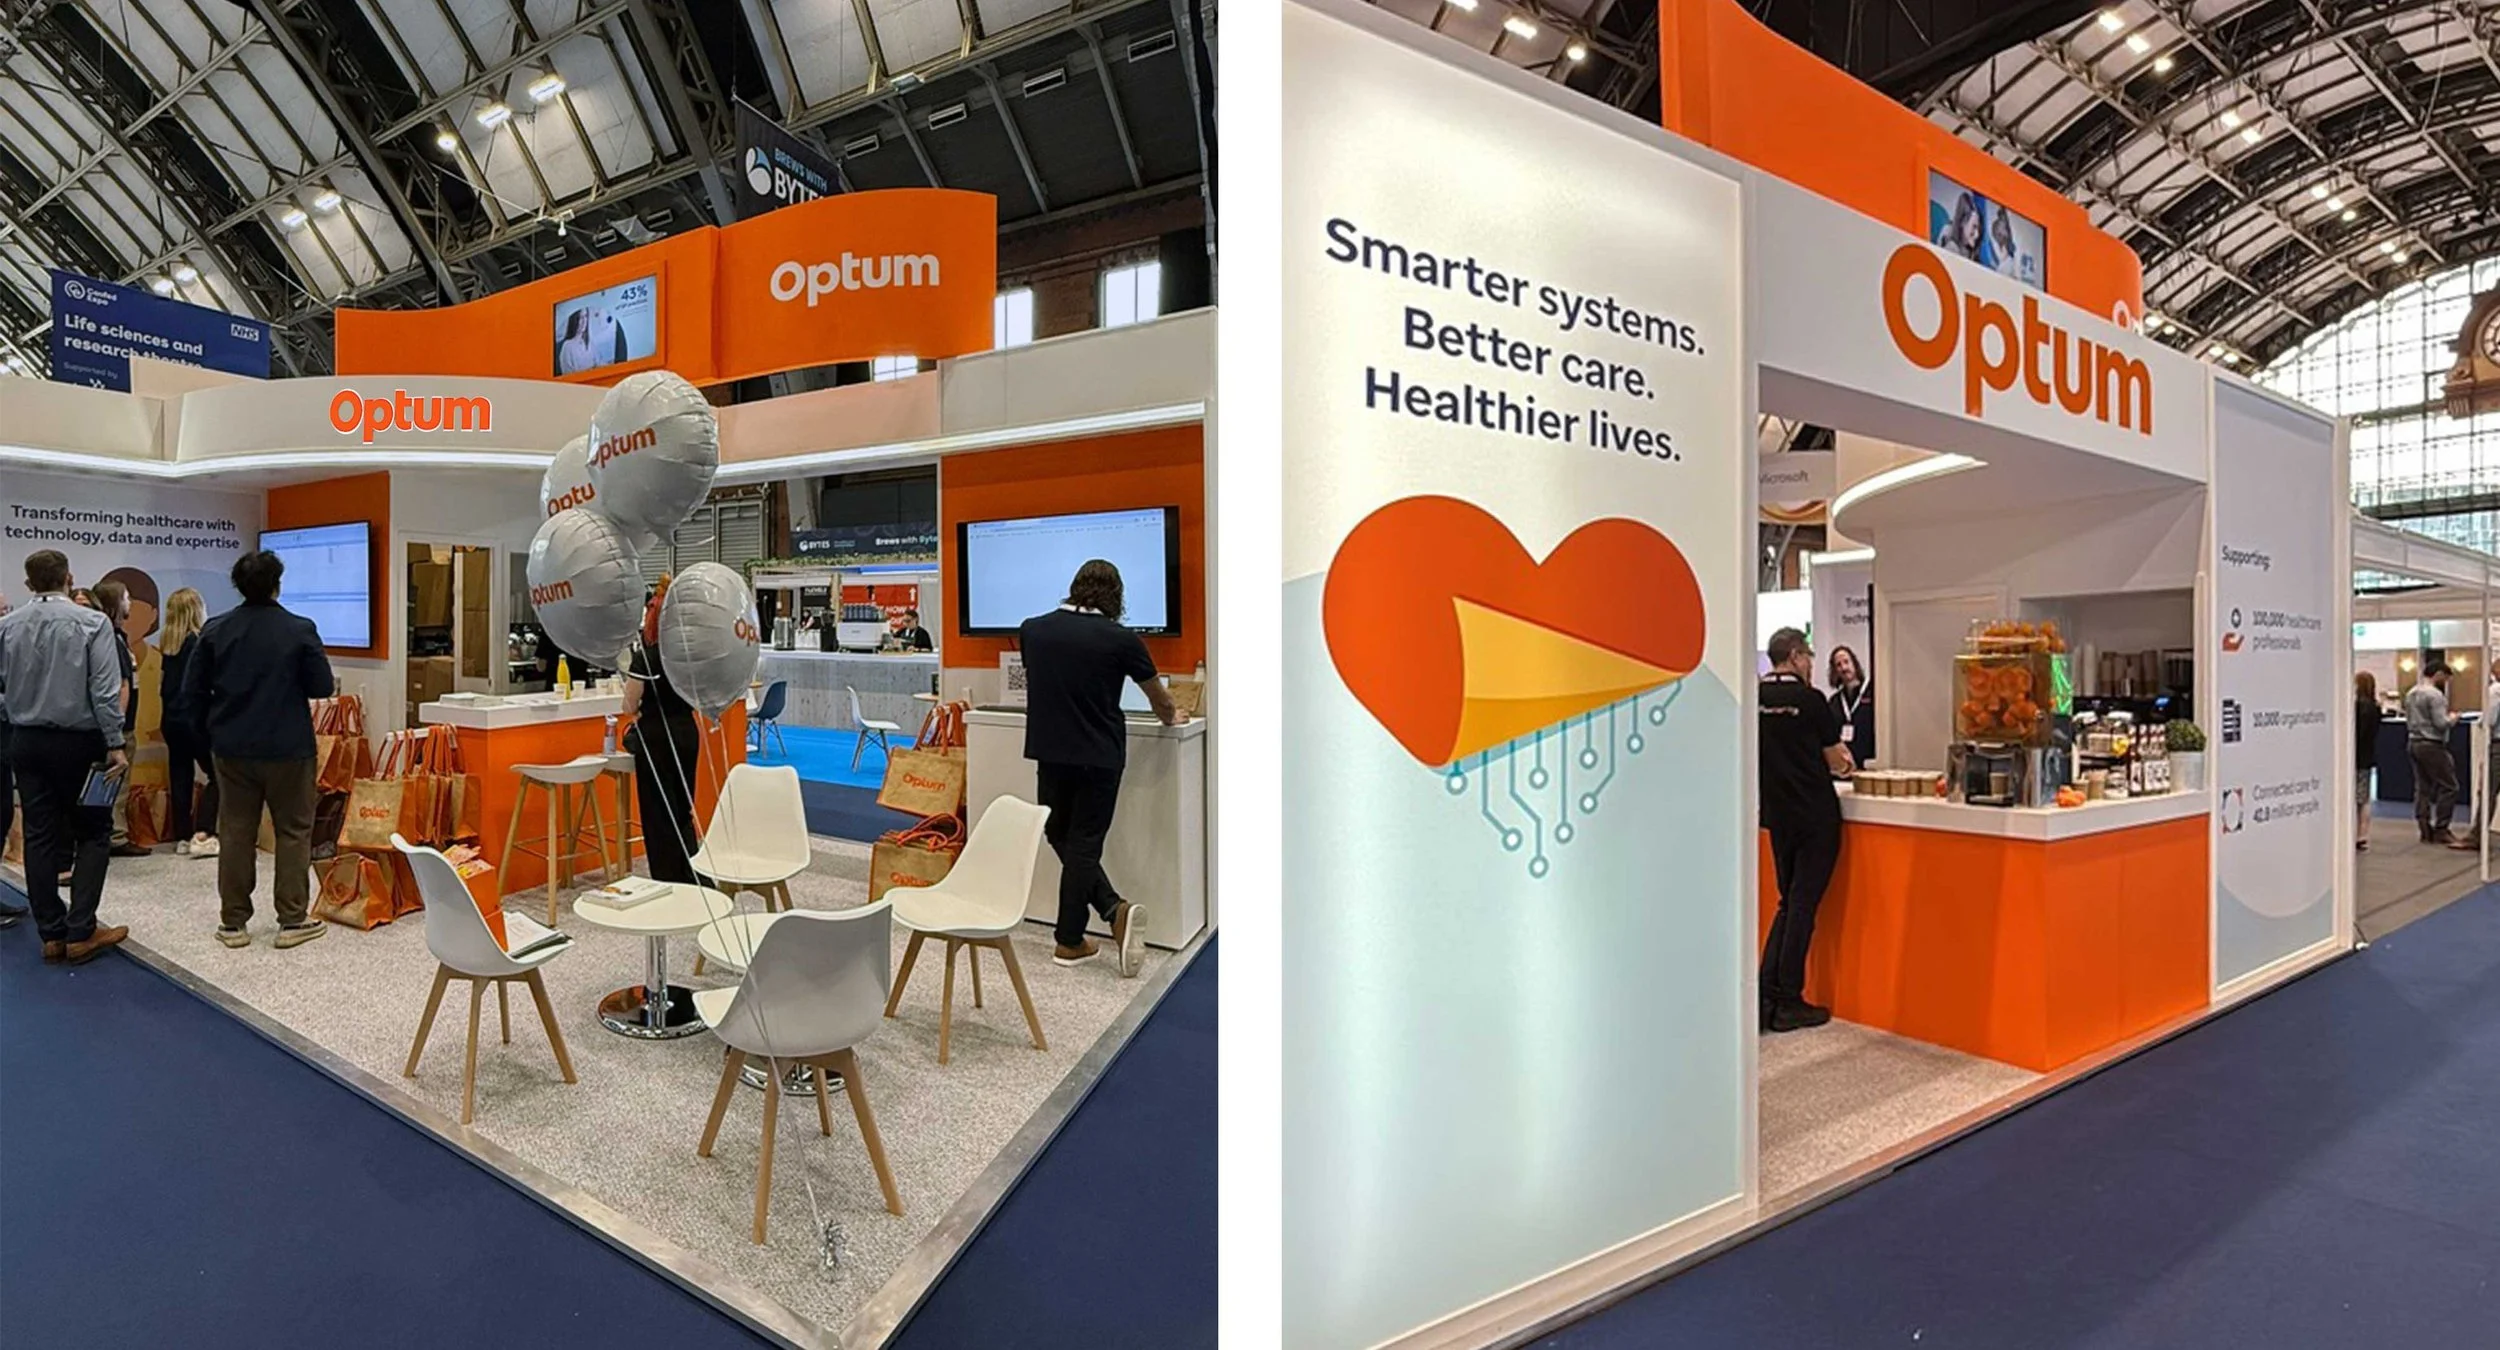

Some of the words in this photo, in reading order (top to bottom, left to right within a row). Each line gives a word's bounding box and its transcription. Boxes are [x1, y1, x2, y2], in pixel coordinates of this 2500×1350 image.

[805, 167, 828, 192] WITH
[620, 284, 648, 300] 43%
[770, 251, 940, 307] Optum
[1325, 217, 1529, 307] Smarter
[1539, 284, 1705, 355] systems.
[64, 313, 97, 332] Life
[100, 325, 169, 349] sciences
[172, 340, 203, 356] and
[231, 323, 259, 341] NHS
[1881, 243, 2153, 436] Optum
[1404, 306, 1551, 375] Better
[1561, 353, 1655, 399] care.
[63, 361, 107, 376] Supported
[329, 388, 492, 444] Optum
[1365, 366, 1580, 442] Healthier
[1589, 410, 1681, 462] lives.
[10, 504, 123, 527] Transforming
[126, 512, 204, 529] healthcare
[206, 518, 236, 531] with
[4, 525, 105, 545] technology,
[108, 531, 142, 545] data
[145, 533, 173, 546] and
[175, 537, 240, 549] expertise
[875, 537, 900, 546] Brews
[901, 536, 918, 545] with
[903, 770, 946, 792] Optum
